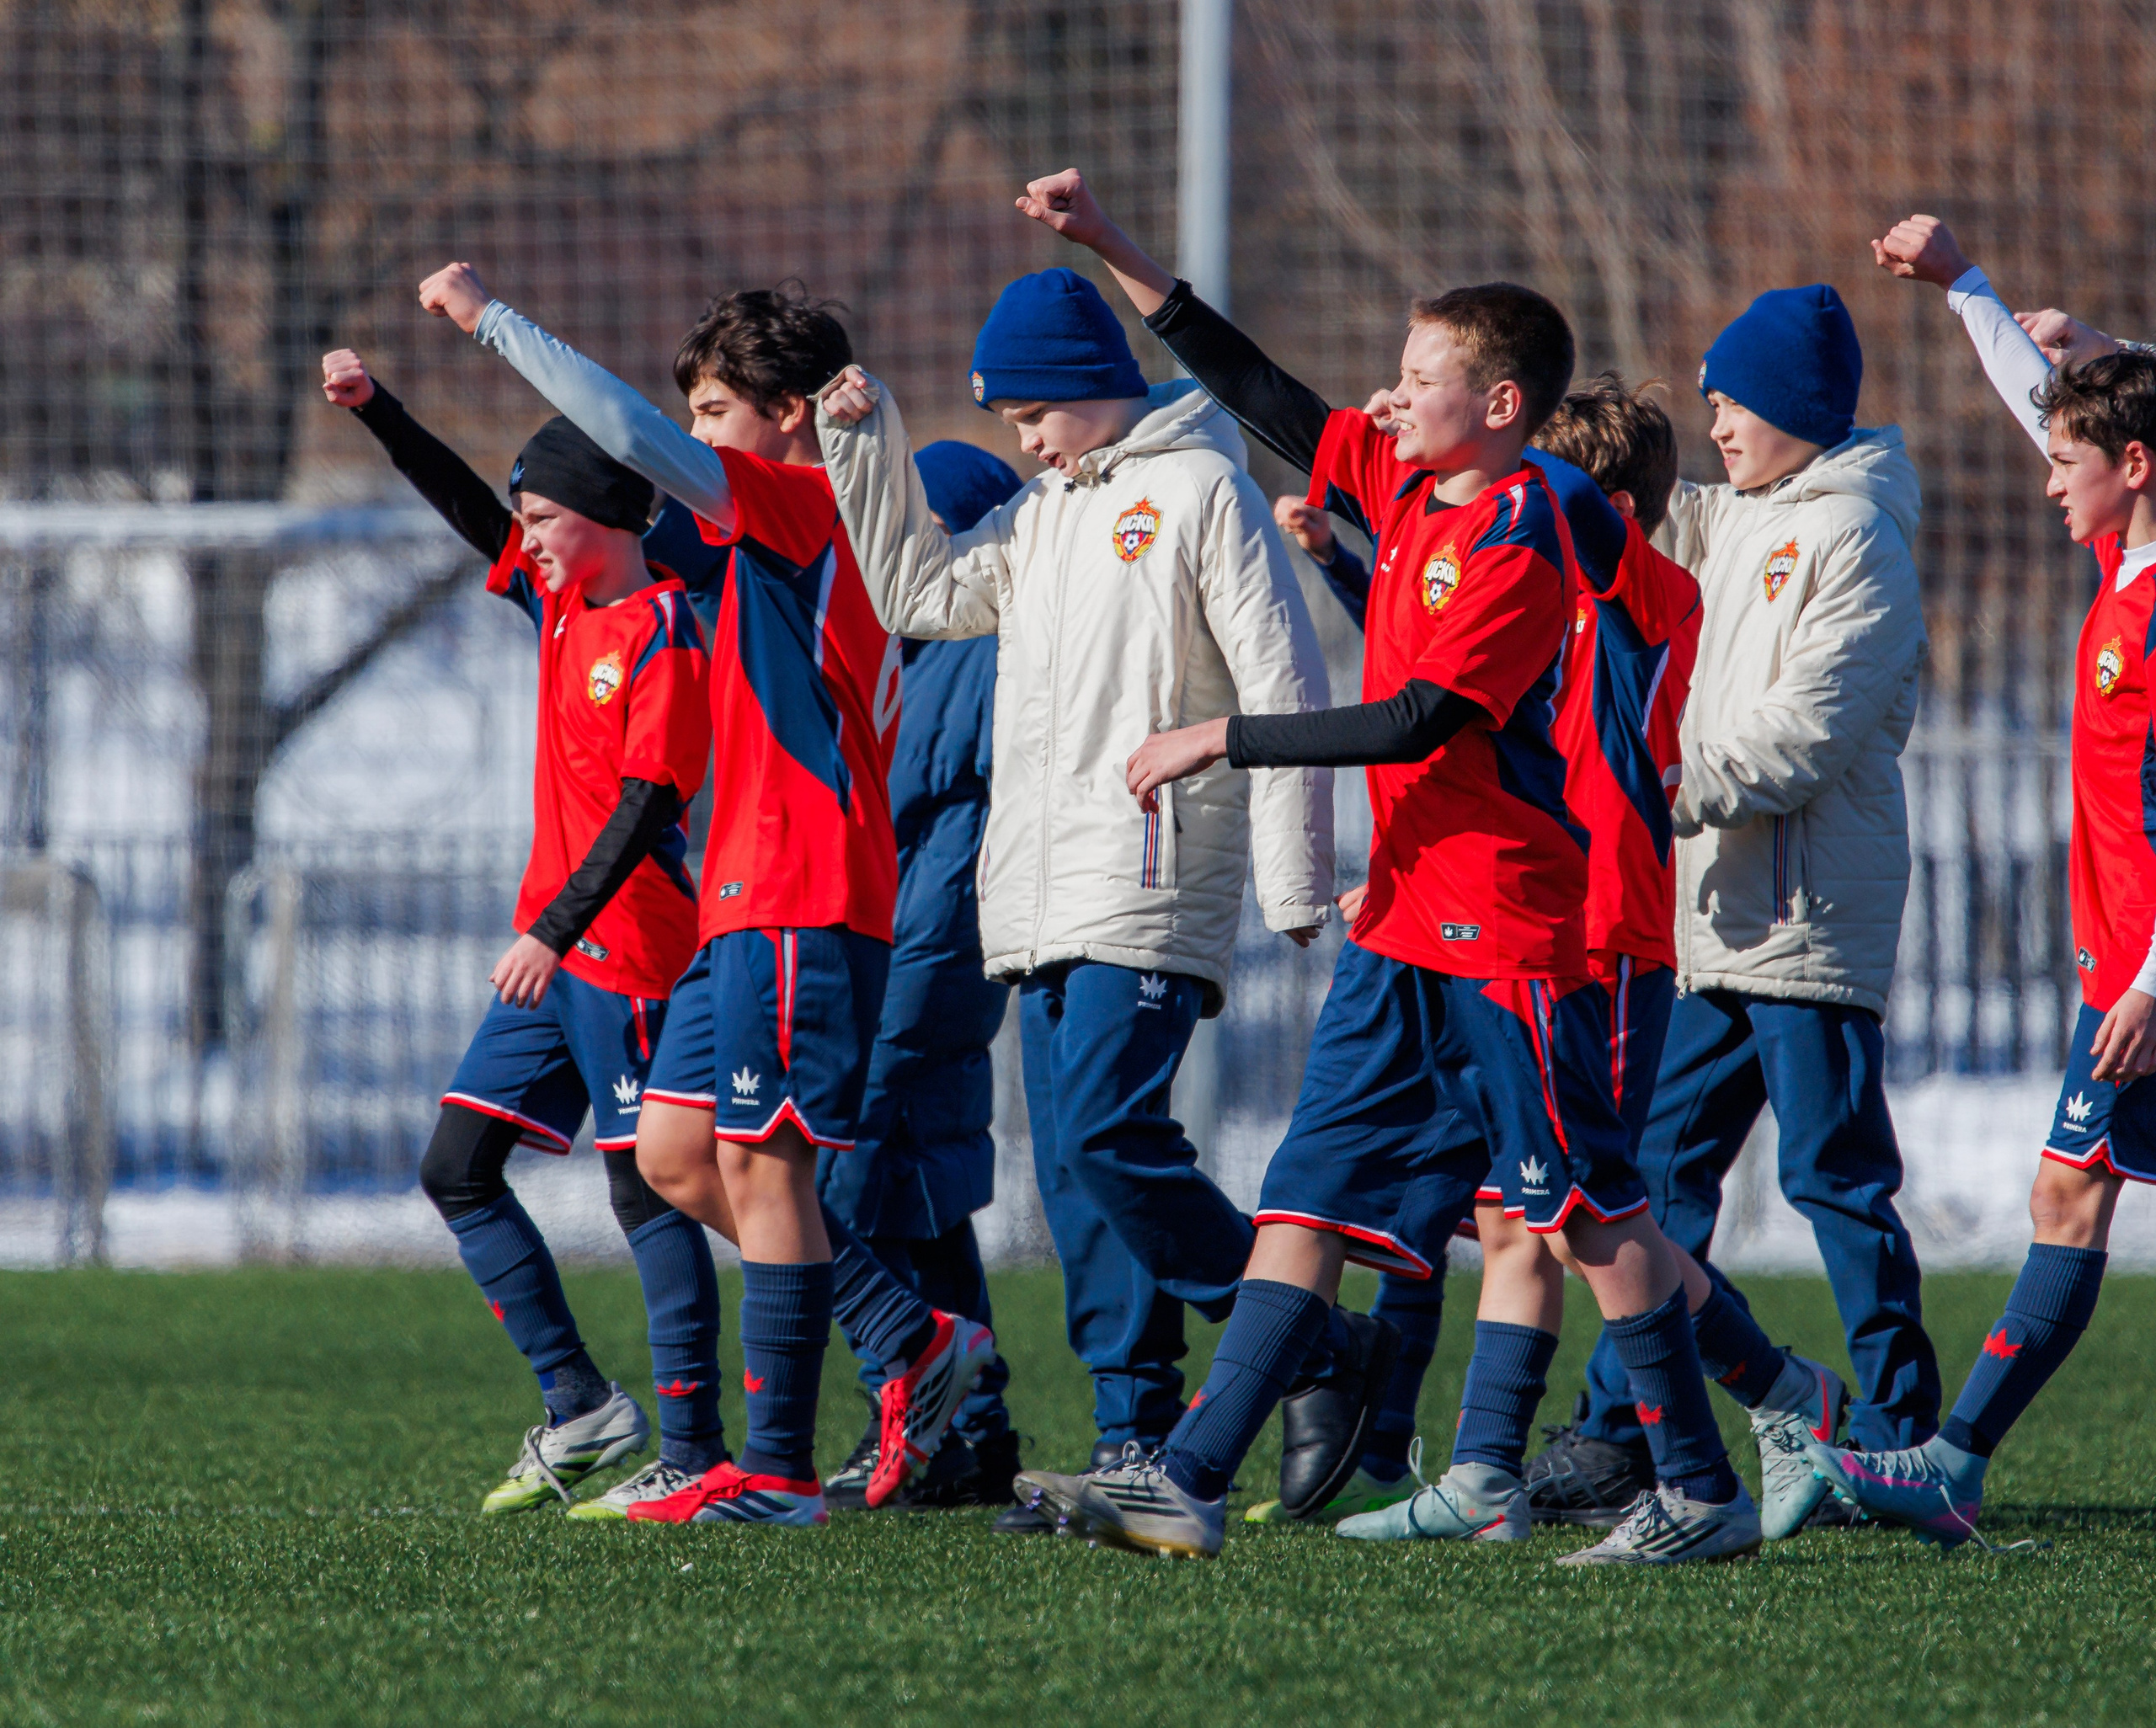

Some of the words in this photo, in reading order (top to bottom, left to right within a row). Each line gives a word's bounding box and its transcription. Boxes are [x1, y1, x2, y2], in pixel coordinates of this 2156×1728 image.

[1116, 515, 1155, 535] ЦСКА
[1425, 561, 1456, 587] ЦСКА
[1767, 557, 1795, 576] ЦСКА
[2098, 650, 2120, 676] ЦСКА
[591, 664, 620, 687] ЦСКА
[2063, 1122, 2087, 1133] PRIMERA
[1521, 1187, 1550, 1196] PRIMERA
